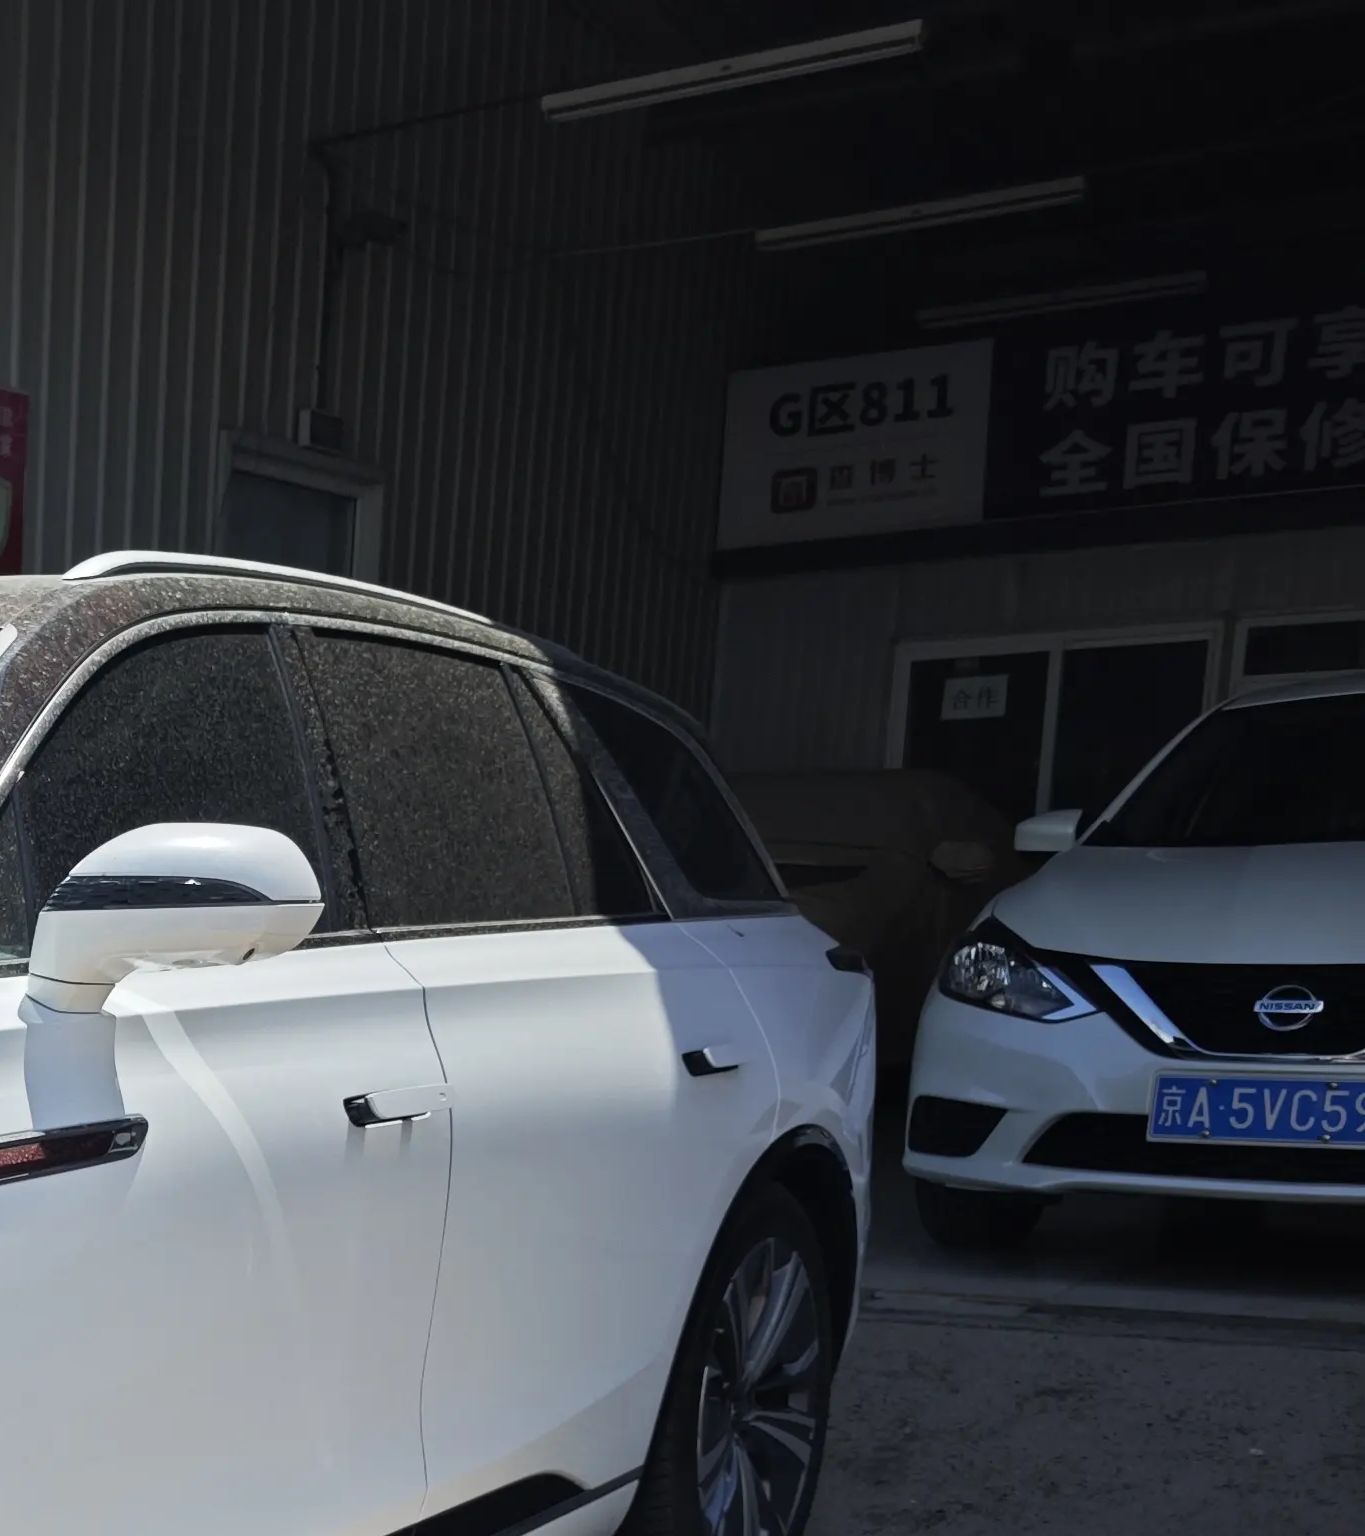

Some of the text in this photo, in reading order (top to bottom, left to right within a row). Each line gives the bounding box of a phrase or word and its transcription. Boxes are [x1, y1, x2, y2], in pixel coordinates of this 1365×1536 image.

[1042, 303, 1365, 411] 购车可享
[769, 374, 954, 437] G区811
[1038, 397, 1365, 499] 全国保修
[1259, 1002, 1316, 1011] NISSAN
